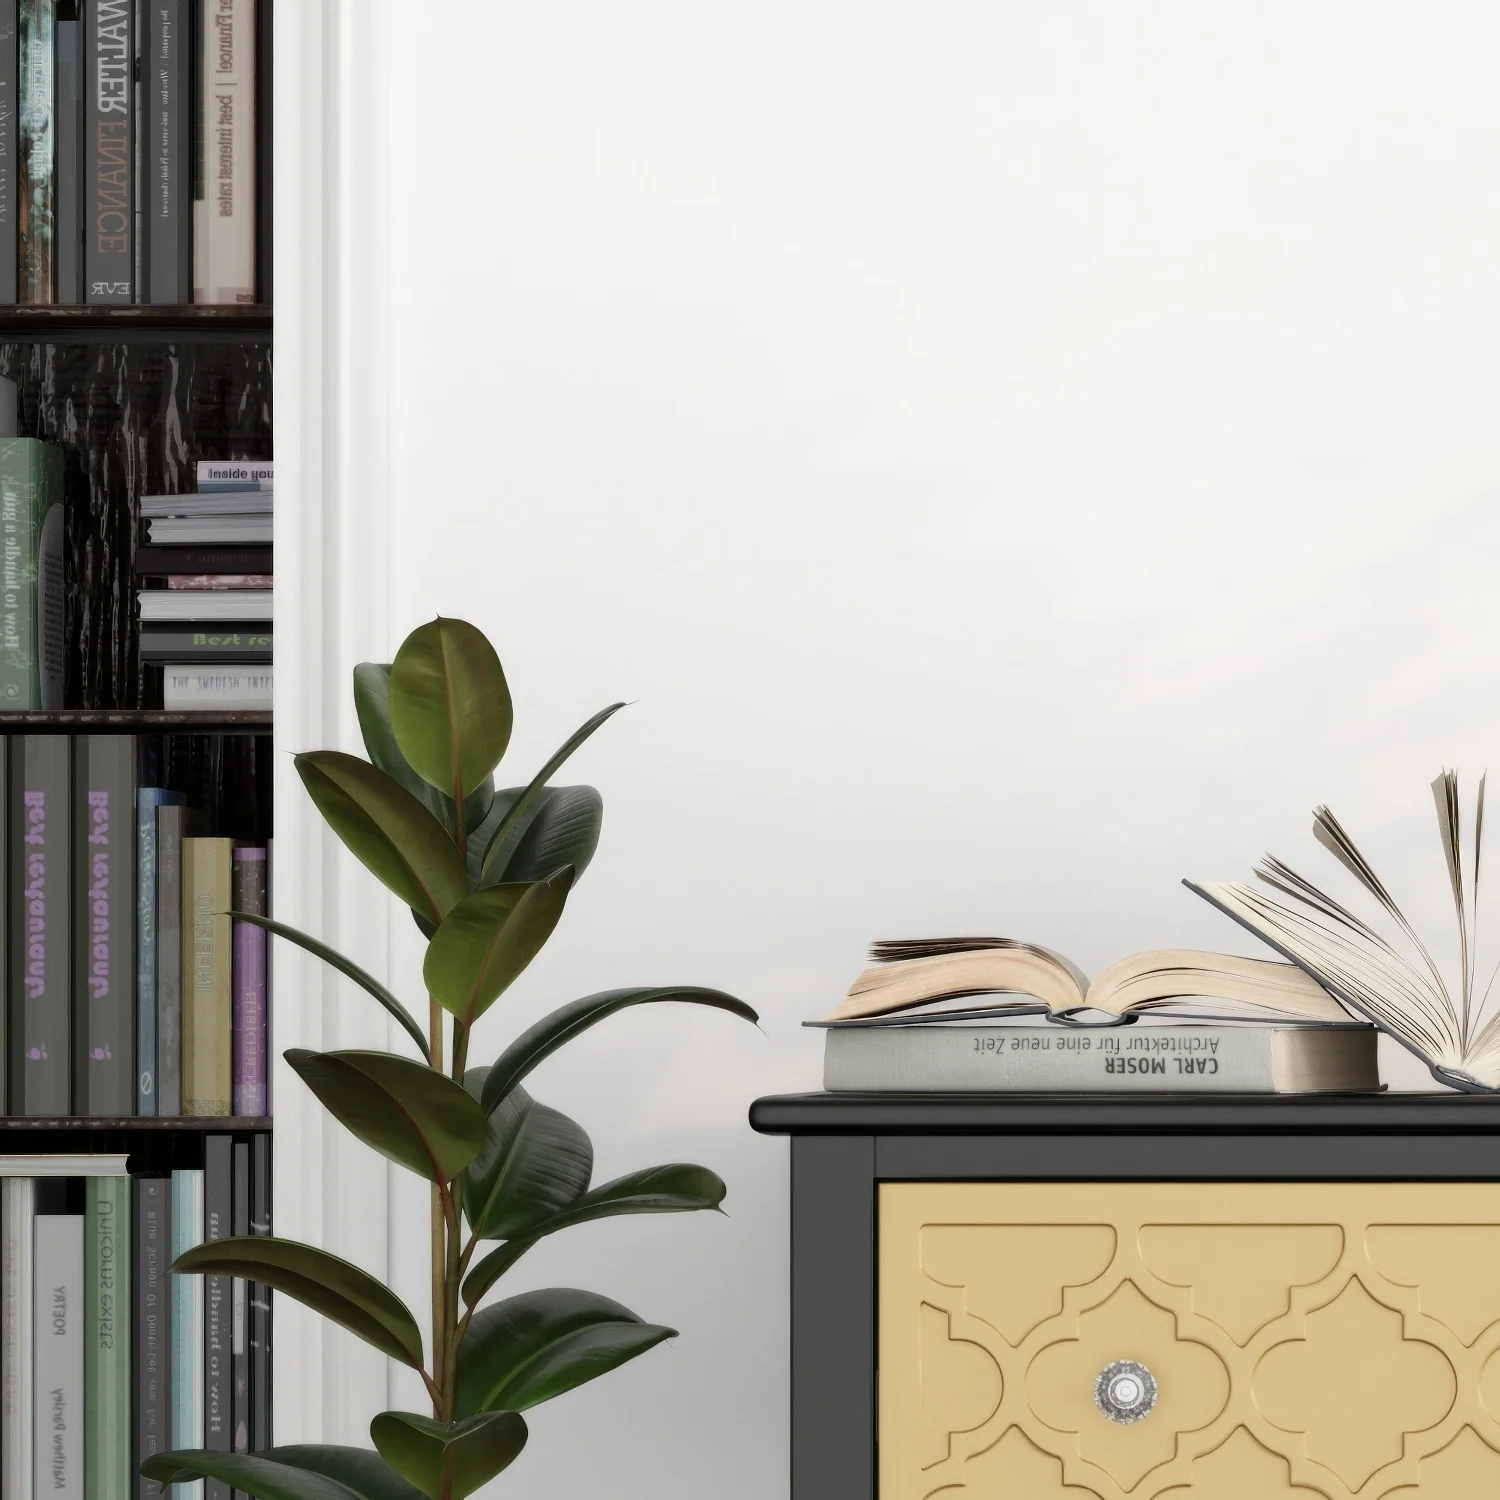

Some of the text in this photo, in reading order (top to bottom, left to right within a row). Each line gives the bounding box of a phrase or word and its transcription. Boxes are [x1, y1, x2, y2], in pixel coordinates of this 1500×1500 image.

[208, 468, 248, 479] Inside
[193, 633, 240, 646] Best
[172, 675, 273, 692] THE SWEDISH INTE
[973, 1037, 1220, 1056] Architektur für eine neue Zeit
[1104, 1057, 1220, 1075] CARL MOSER
